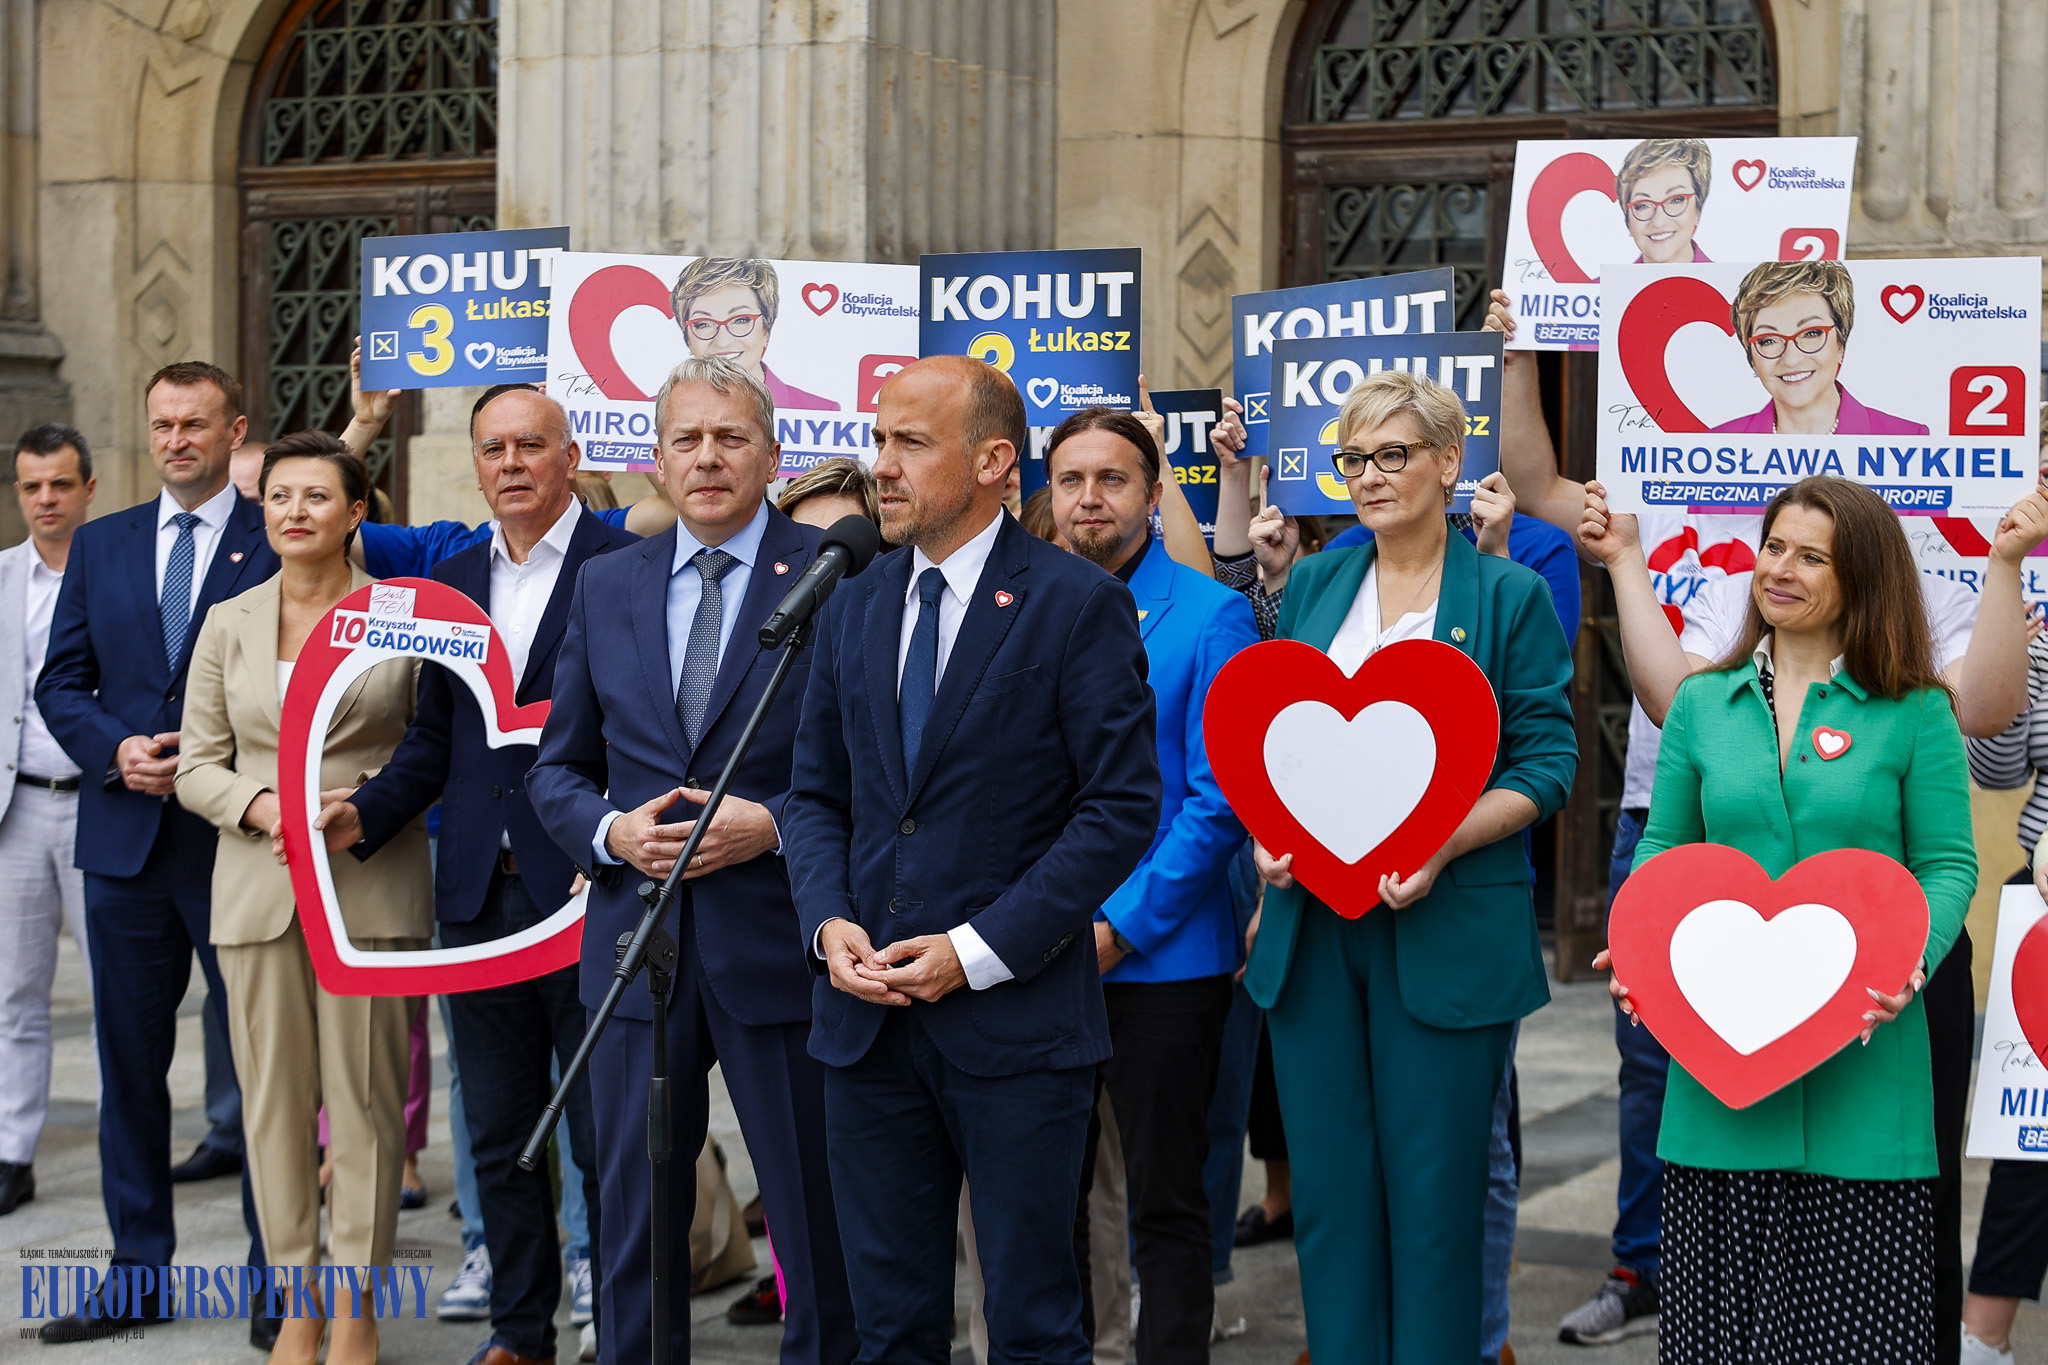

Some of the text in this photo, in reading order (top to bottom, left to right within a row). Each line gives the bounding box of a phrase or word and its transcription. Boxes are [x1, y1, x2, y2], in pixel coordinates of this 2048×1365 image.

[1769, 167, 1816, 179] Koalicja
[1768, 178, 1845, 191] Obywatelska
[372, 247, 563, 296] KOHUT
[842, 292, 893, 307] Koalicja
[931, 271, 1134, 321] KOHUT
[1928, 293, 1988, 308] Koalicja
[1928, 306, 2027, 322] Obywatelska
[1244, 290, 1446, 356] KOHUT
[407, 303, 454, 376] 3
[1028, 326, 1131, 352] Łukasz
[496, 345, 537, 357] Koalicja
[558, 373, 607, 398] Tak!
[1060, 384, 1104, 396] Koalicja
[1060, 394, 1131, 407] Obywatelska
[1965, 374, 2008, 426] 2
[1608, 403, 1663, 433] Tak!
[1621, 446, 2024, 478] MIROSŁAWA NYKIEL
[1648, 485, 1760, 502] BEZPIECZNA
[372, 586, 407, 600] Just
[372, 600, 415, 615] TEN
[333, 615, 367, 644] 10
[368, 617, 418, 632] Krzysztof
[366, 630, 485, 660] GADOWSKI
